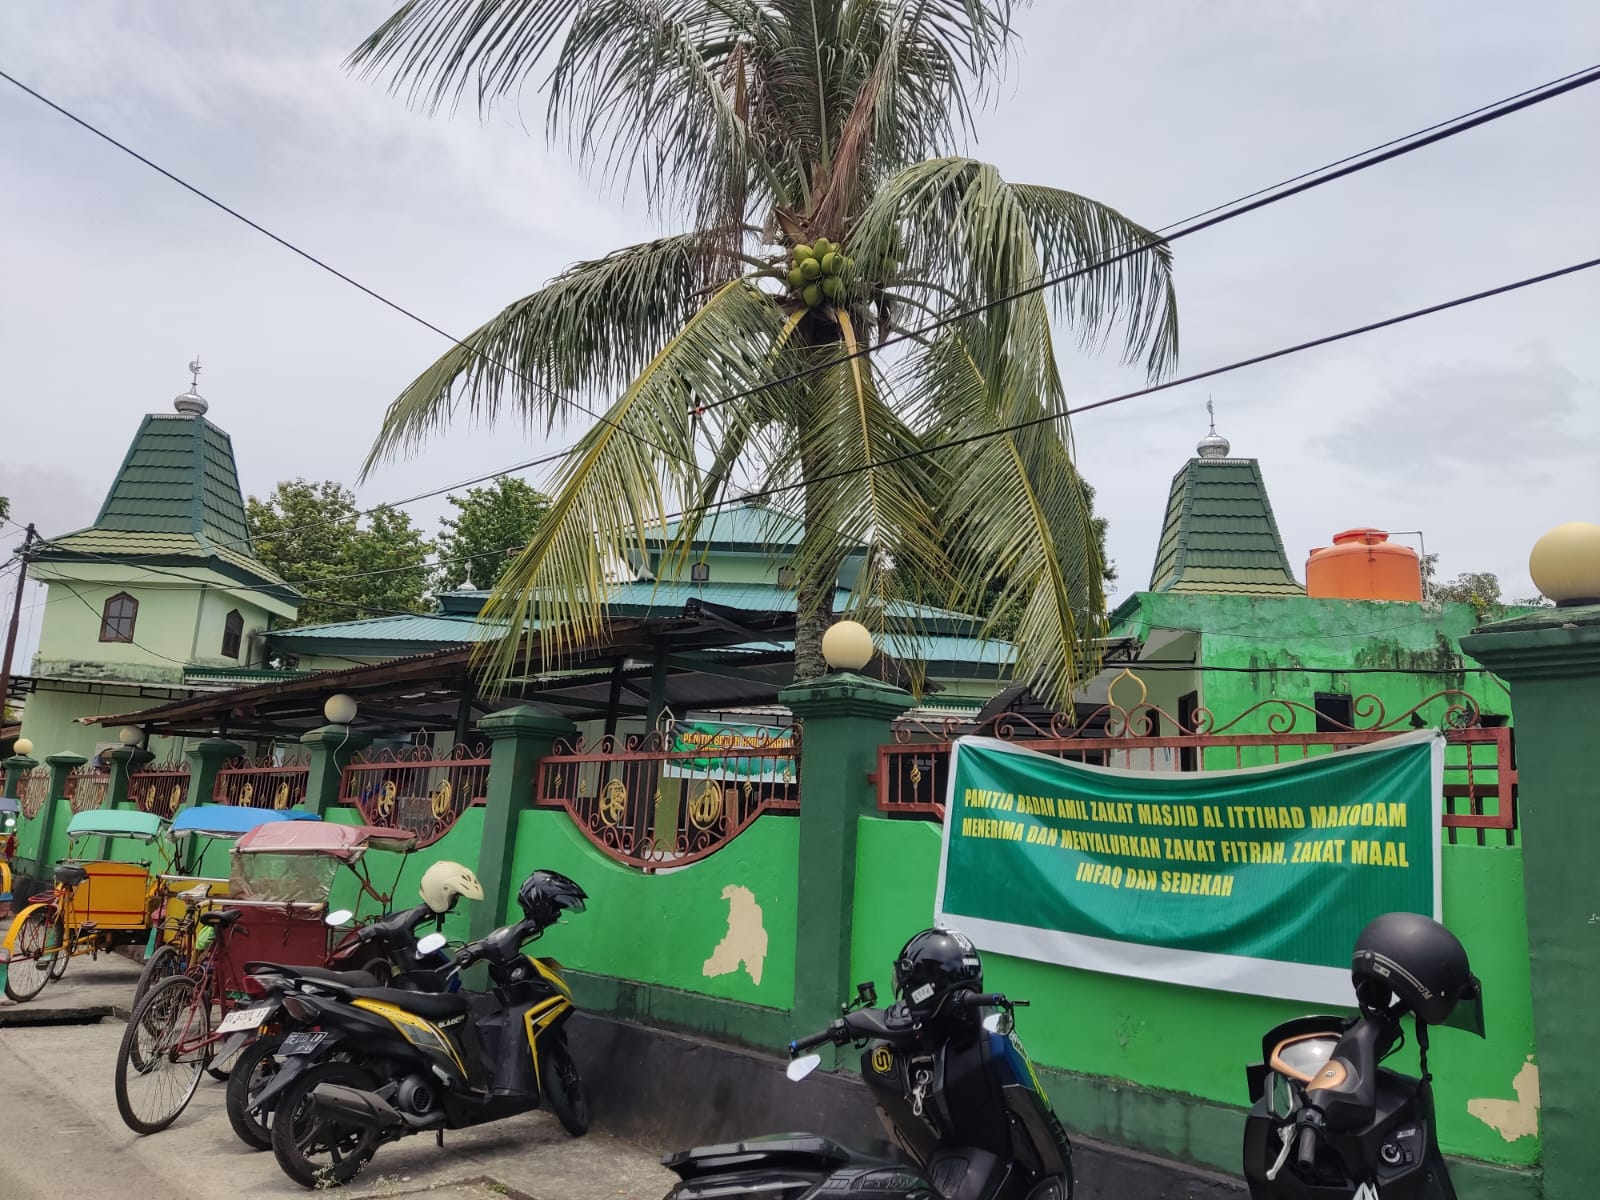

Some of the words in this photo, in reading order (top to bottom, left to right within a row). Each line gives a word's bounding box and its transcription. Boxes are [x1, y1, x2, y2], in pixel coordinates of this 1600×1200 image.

[964, 788, 1013, 812] PANITIA
[1016, 794, 1055, 817] BADAN
[1057, 799, 1089, 820] AMIL
[1091, 801, 1133, 824] ZAKAT
[1138, 804, 1198, 827] MASJID
[1203, 806, 1224, 828] AL
[1227, 806, 1305, 829] ITTIHAD
[962, 818, 1024, 841] MENERIMA
[1026, 825, 1058, 847] DAN
[1060, 829, 1161, 859] MENYALURKAN
[1164, 838, 1216, 862] ZAKAT
[1220, 841, 1287, 866] FITRAH,
[1291, 840, 1345, 864] ZAKAT
[1351, 840, 1409, 867] MAAL
[1075, 862, 1122, 889] INFAQ
[1125, 869, 1157, 891] DAN
[1161, 871, 1234, 897] SEDEKAH
